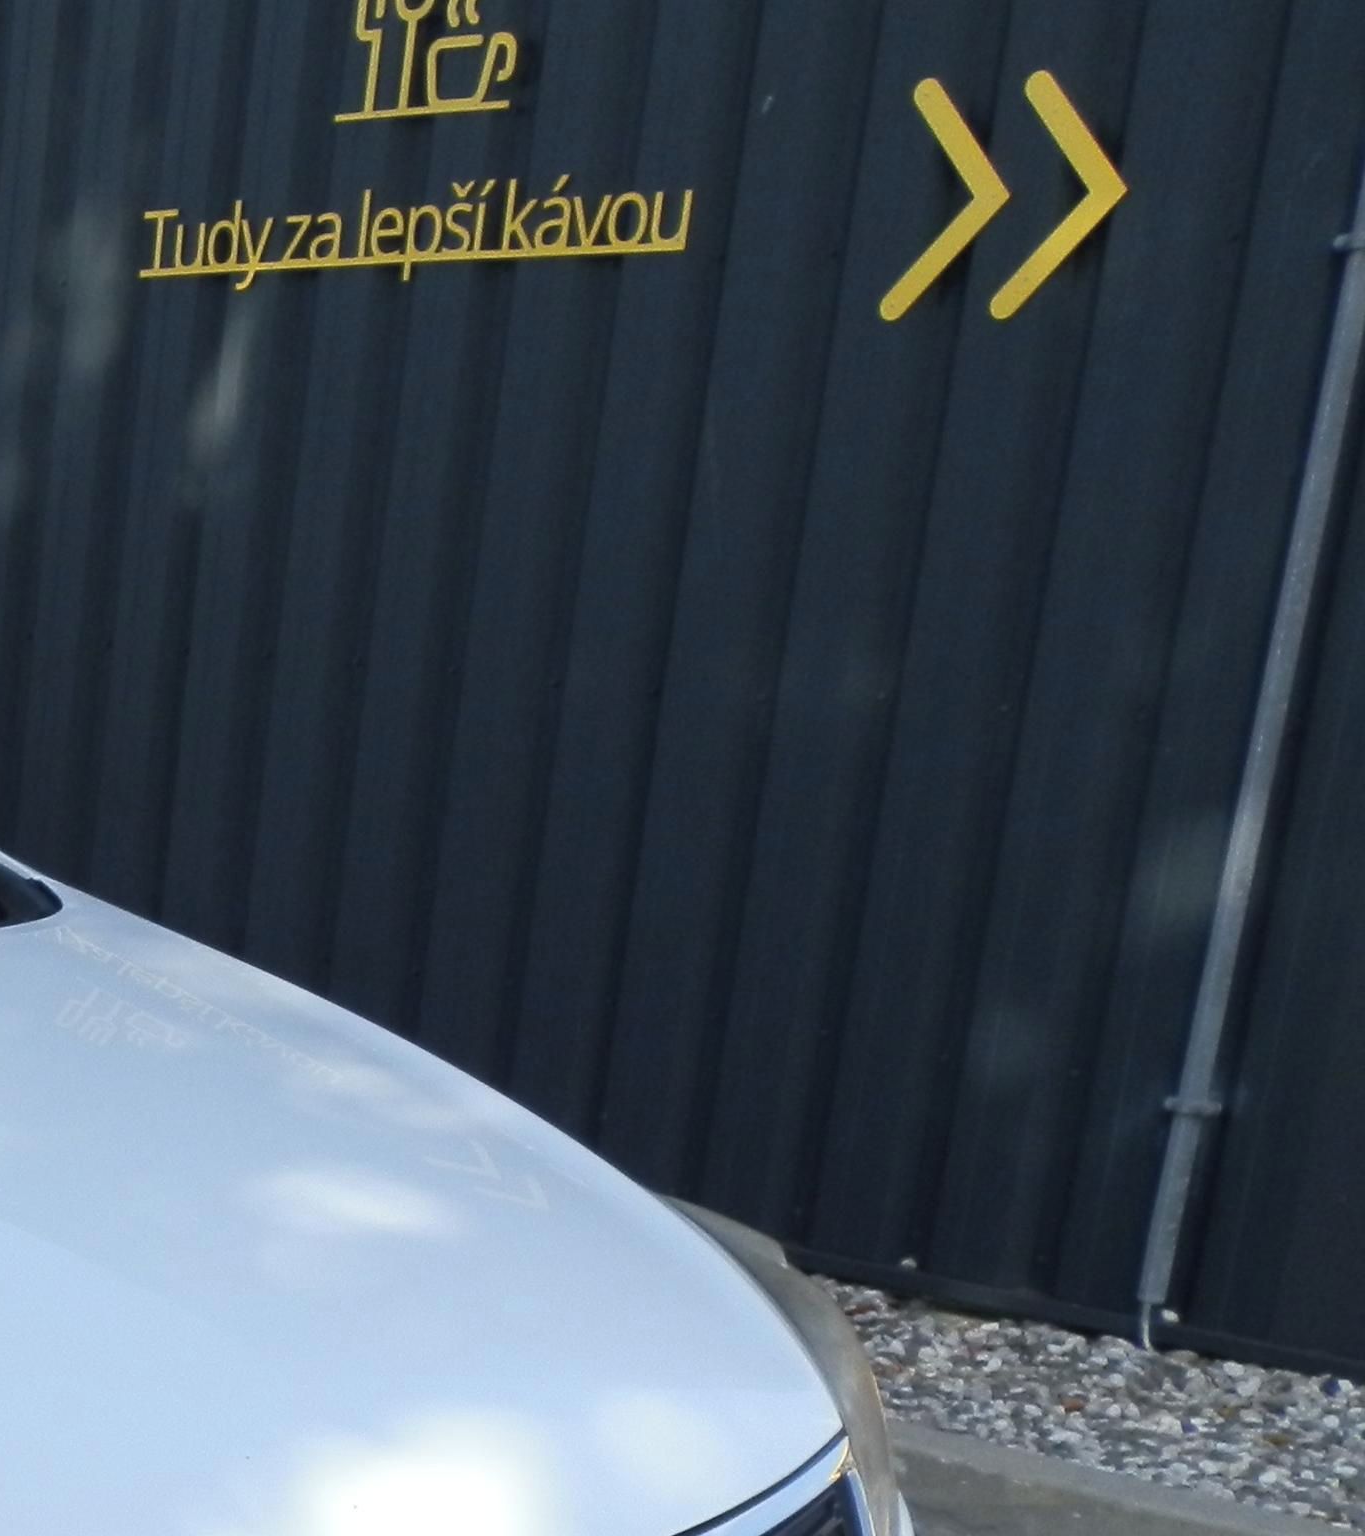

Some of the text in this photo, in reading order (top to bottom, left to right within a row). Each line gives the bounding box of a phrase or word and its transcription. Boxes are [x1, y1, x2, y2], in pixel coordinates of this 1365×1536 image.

[143, 175, 693, 290] Tudy za lepší kávou
